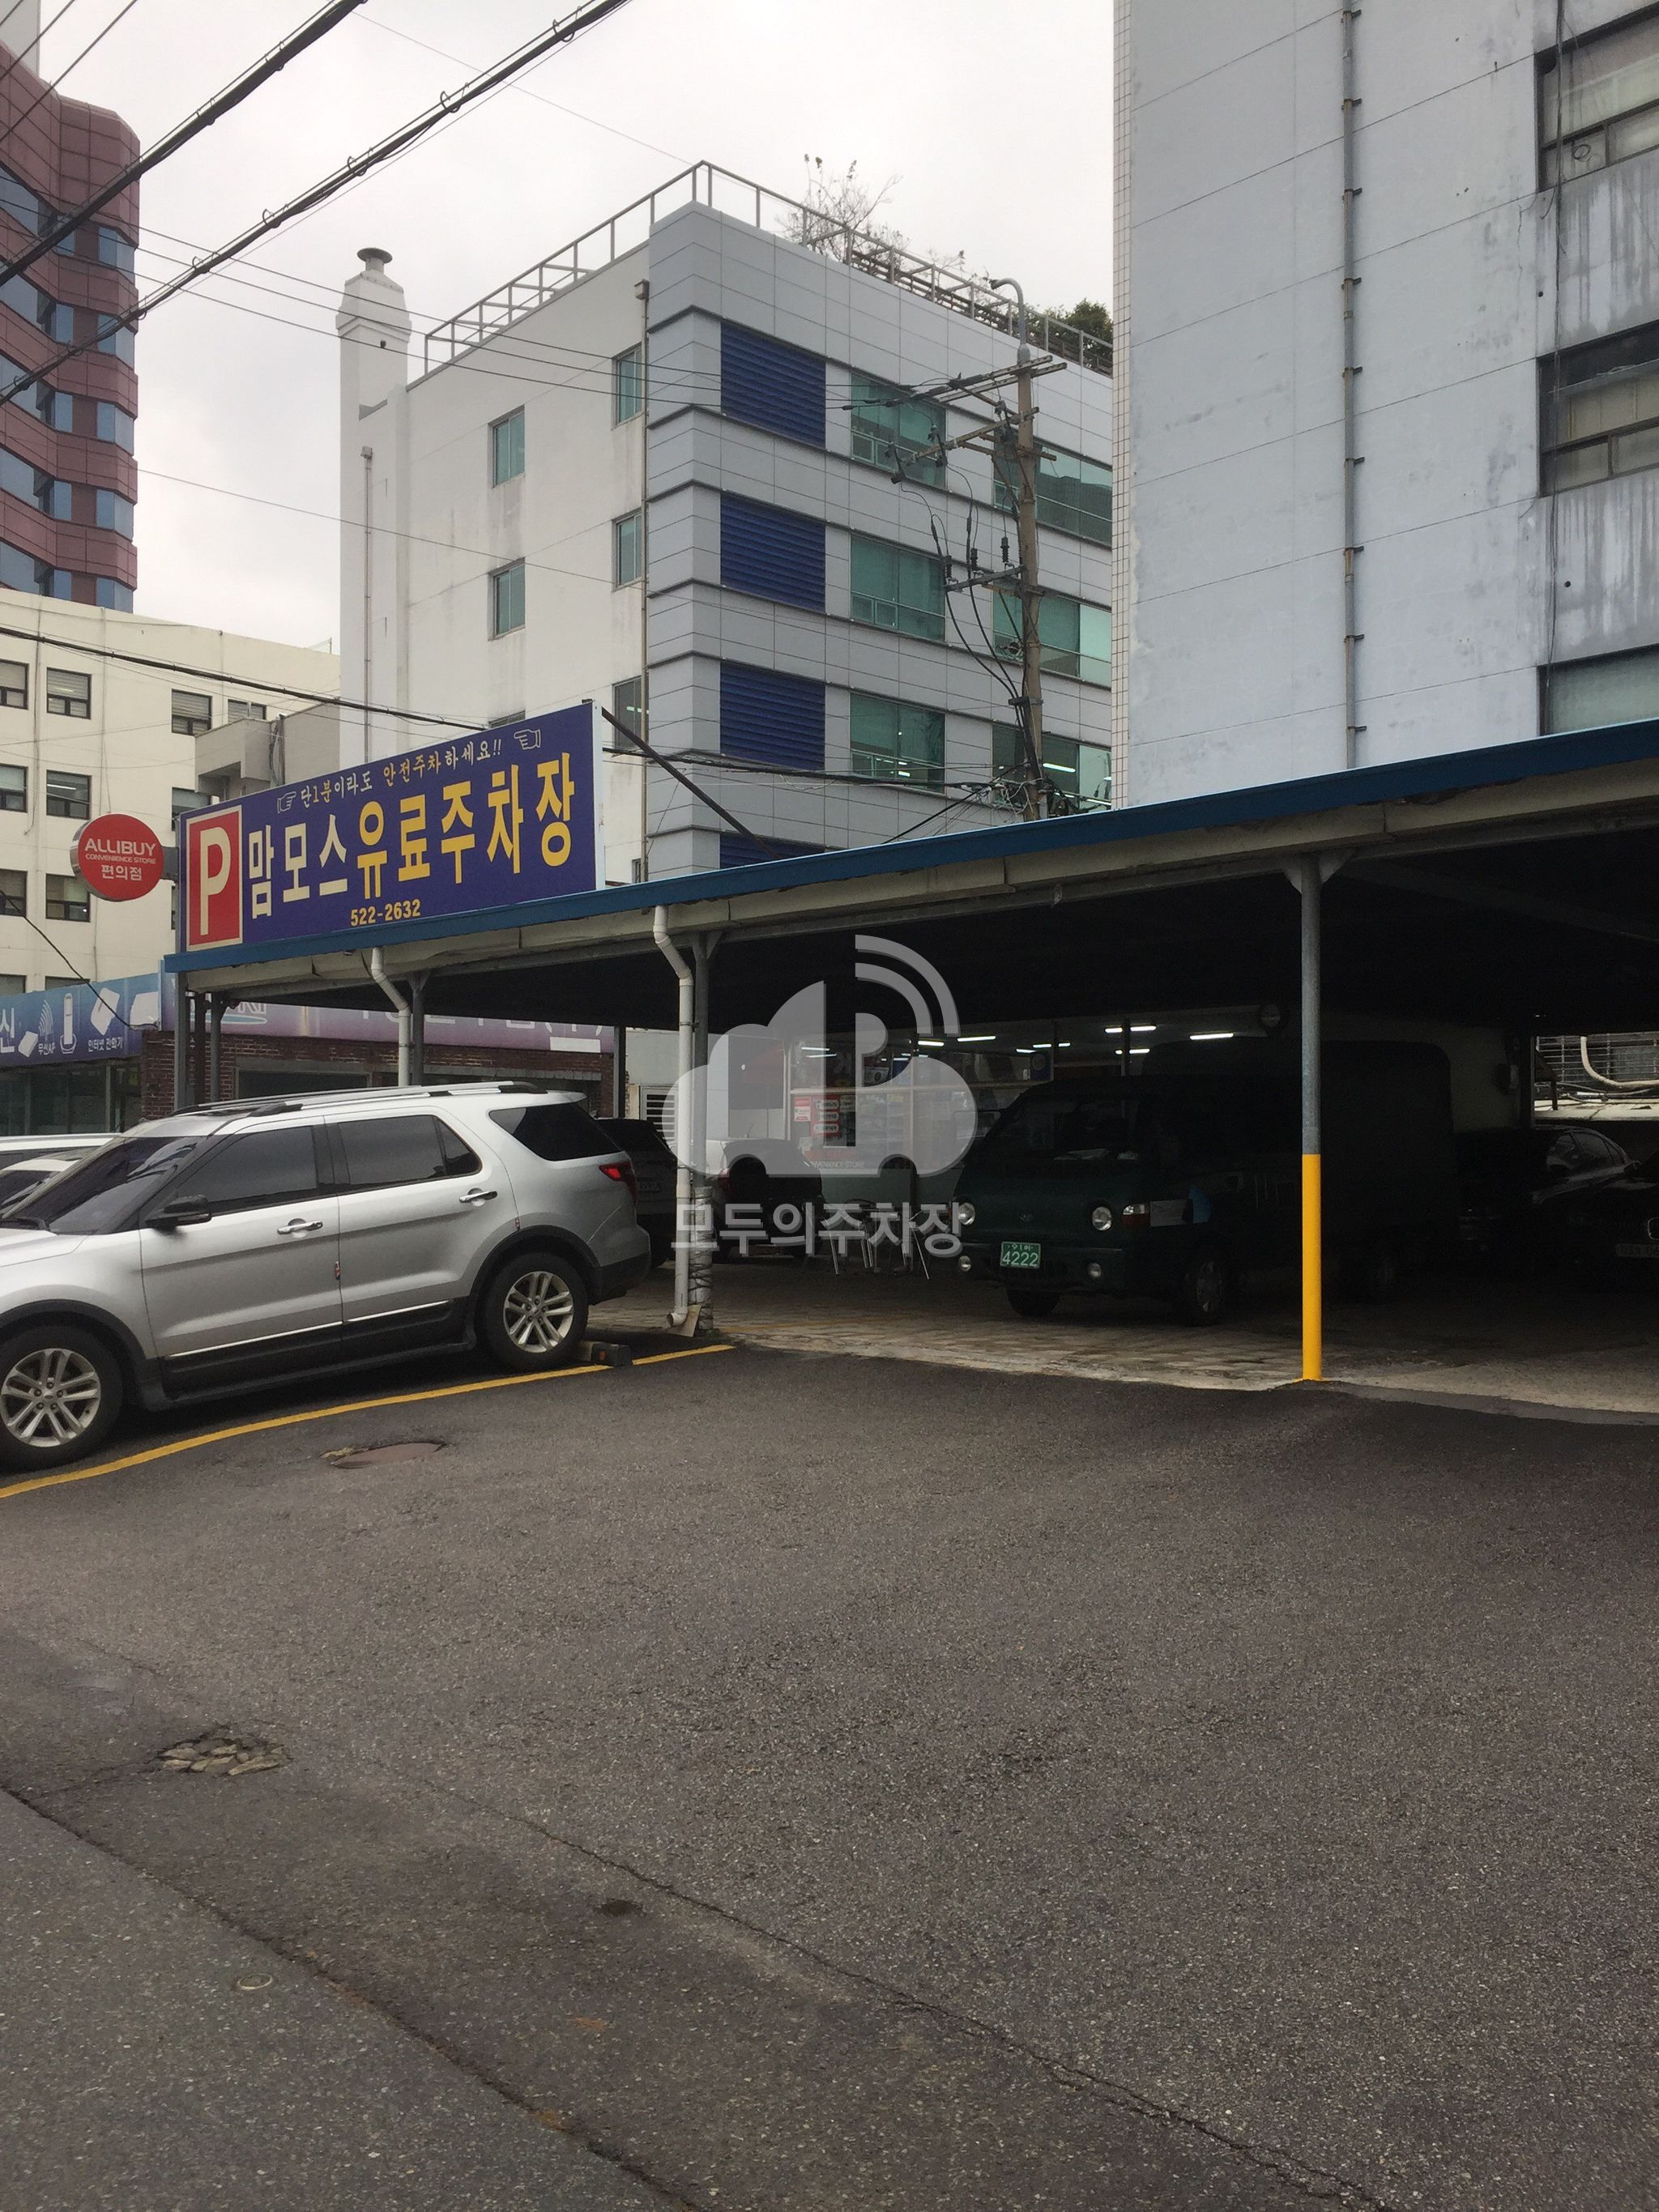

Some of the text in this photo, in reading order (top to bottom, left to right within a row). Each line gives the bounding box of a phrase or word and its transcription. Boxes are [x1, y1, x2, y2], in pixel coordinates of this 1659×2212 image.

[301, 771, 373, 808] 단1분이라도
[84, 838, 156, 856] ALLIBUY
[85, 854, 156, 864] CONVENIENCE STORE
[101, 864, 142, 881] 편의점
[200, 826, 231, 936] P
[351, 898, 421, 927] 522-2632
[1002, 1251, 1038, 1267] 4222
